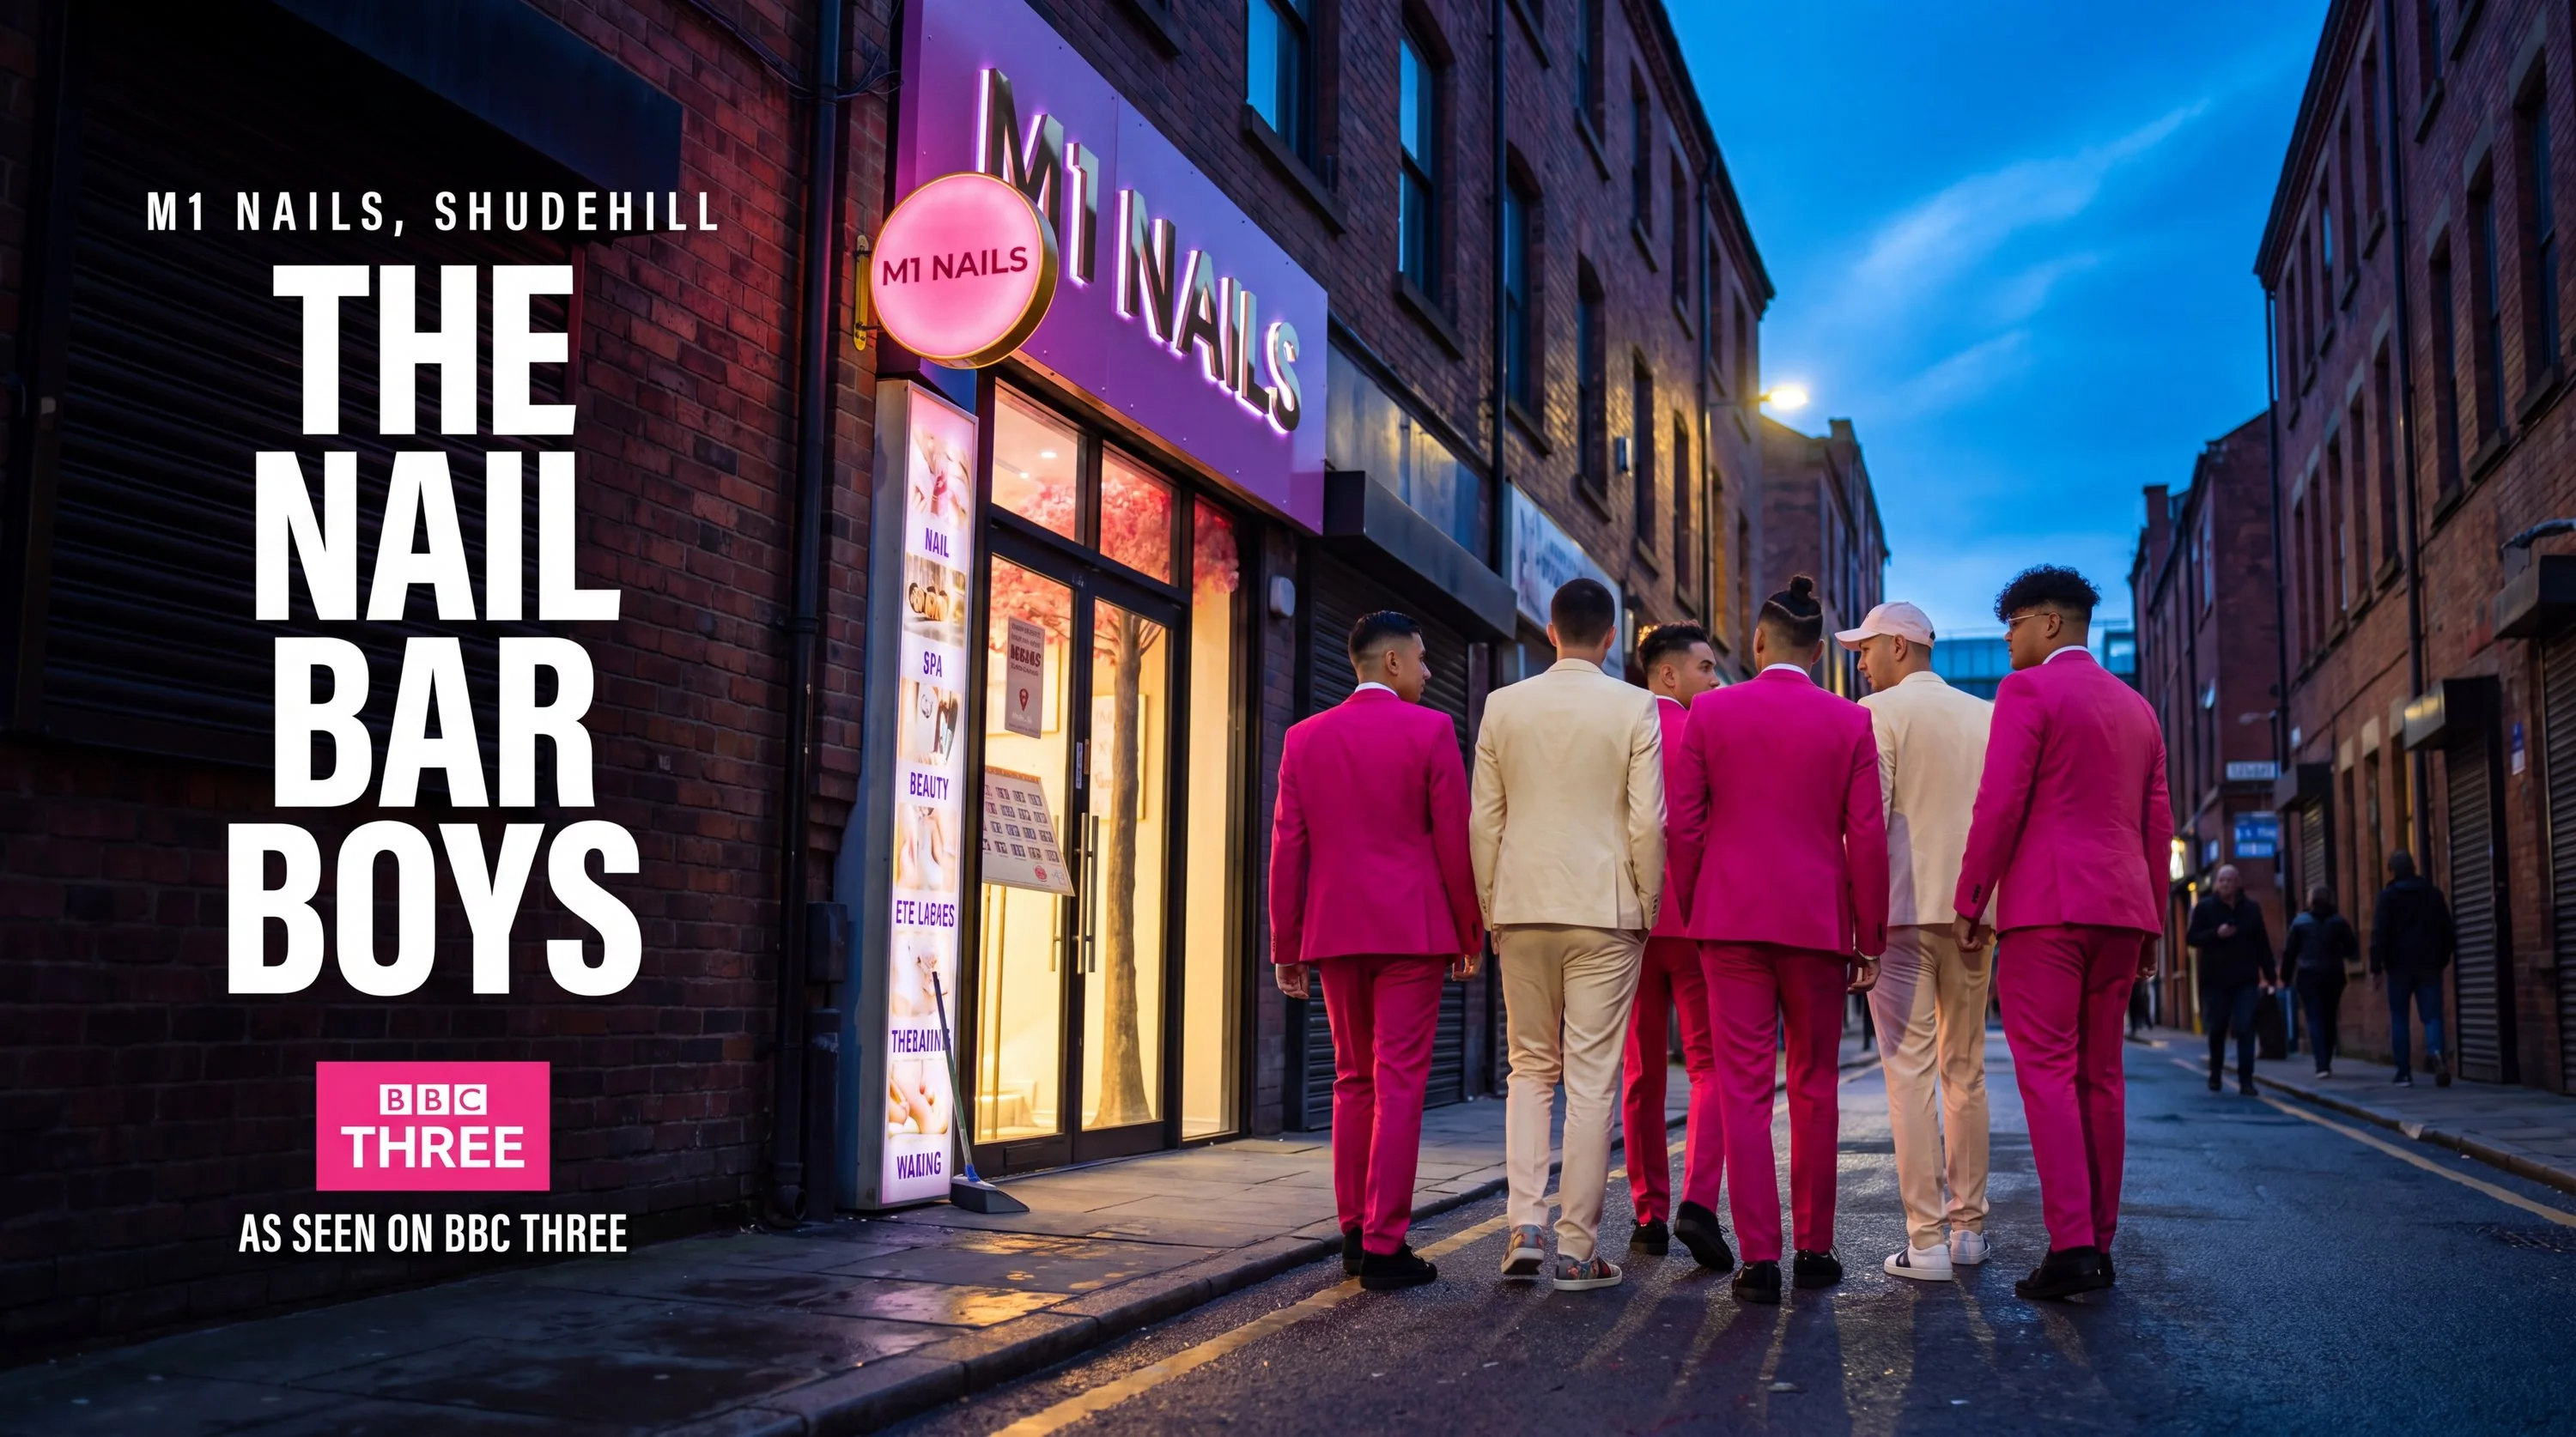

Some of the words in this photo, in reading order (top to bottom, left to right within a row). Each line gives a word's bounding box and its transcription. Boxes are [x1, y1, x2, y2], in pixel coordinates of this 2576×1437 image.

[980, 68, 1099, 284] M1
[1119, 189, 1301, 432] NAILS
[883, 257, 920, 286] M1
[933, 246, 1029, 281] NAILS
[925, 527, 949, 558] NAIL
[923, 651, 942, 677] SPA
[909, 772, 949, 800] BEAUTY
